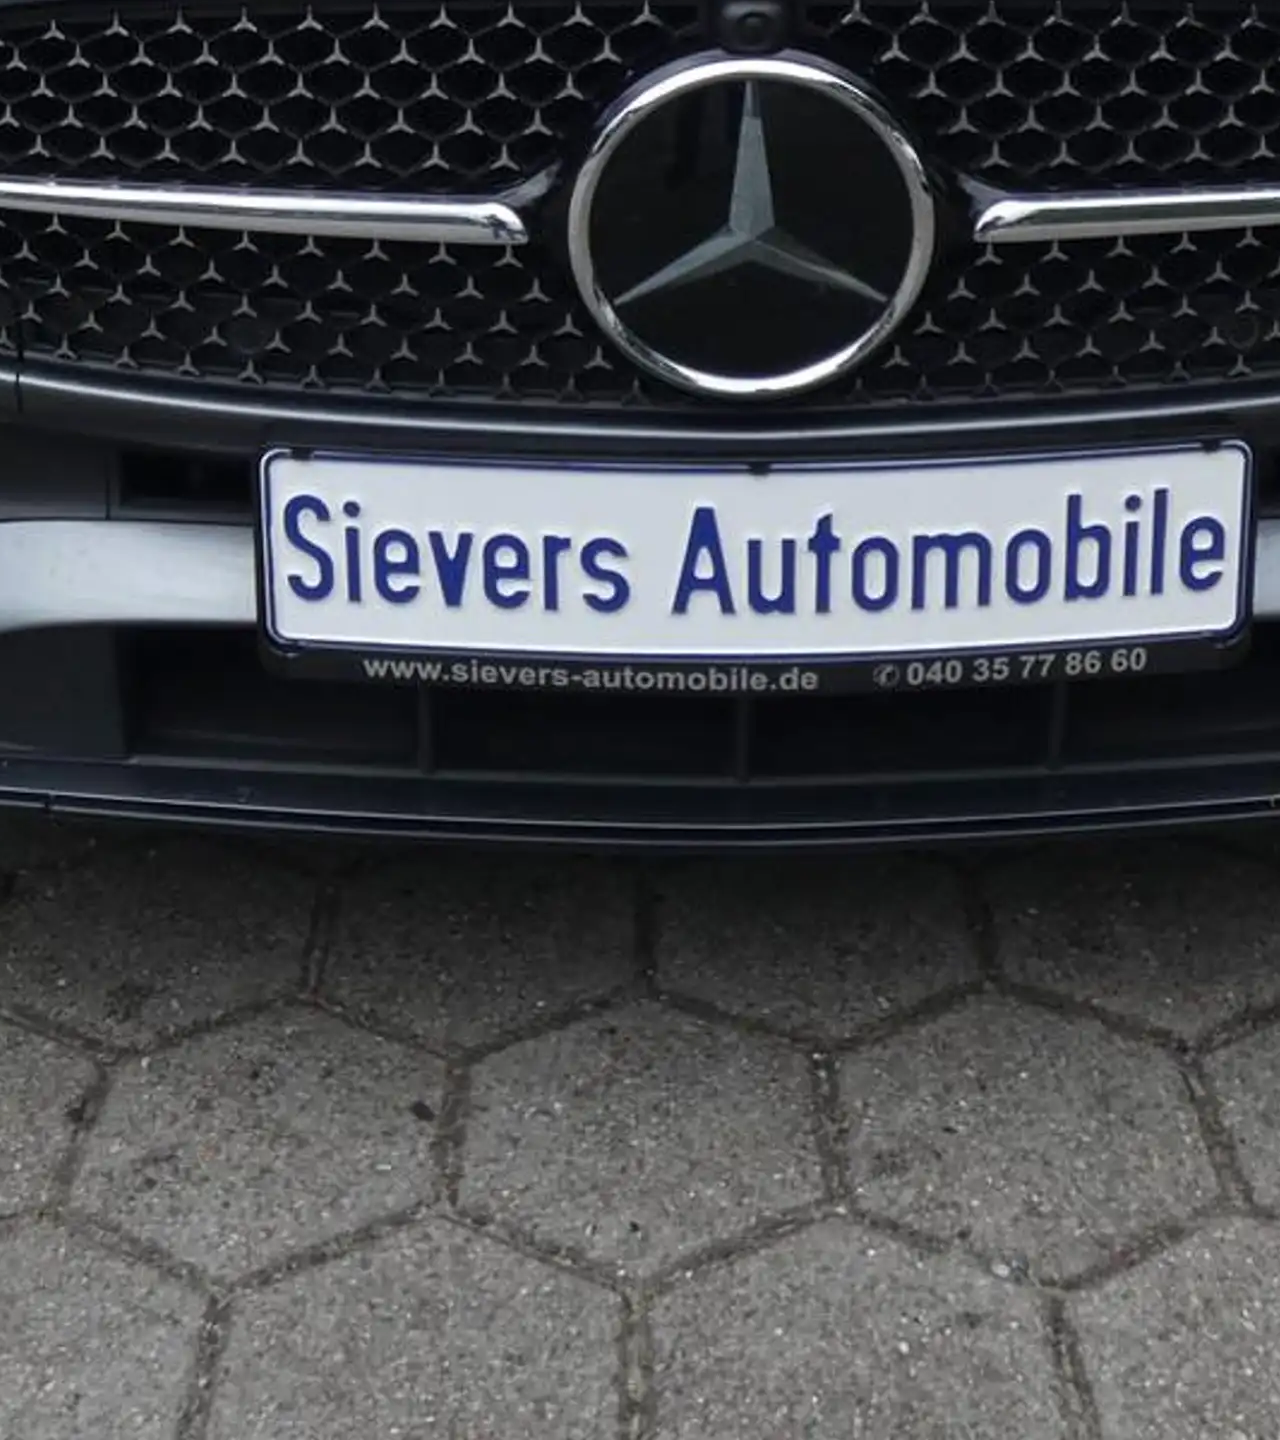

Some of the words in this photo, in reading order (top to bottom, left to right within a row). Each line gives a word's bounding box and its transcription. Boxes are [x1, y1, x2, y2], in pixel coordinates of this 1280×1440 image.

[283, 494, 631, 614] Sievers
[671, 487, 1227, 614] Automobile
[363, 659, 819, 691] www.sievers-automobile.de
[906, 660, 963, 686] 040
[972, 657, 1010, 682] 35
[1020, 653, 1056, 678] 77
[1065, 649, 1102, 675] 86
[1110, 647, 1148, 672] 60
